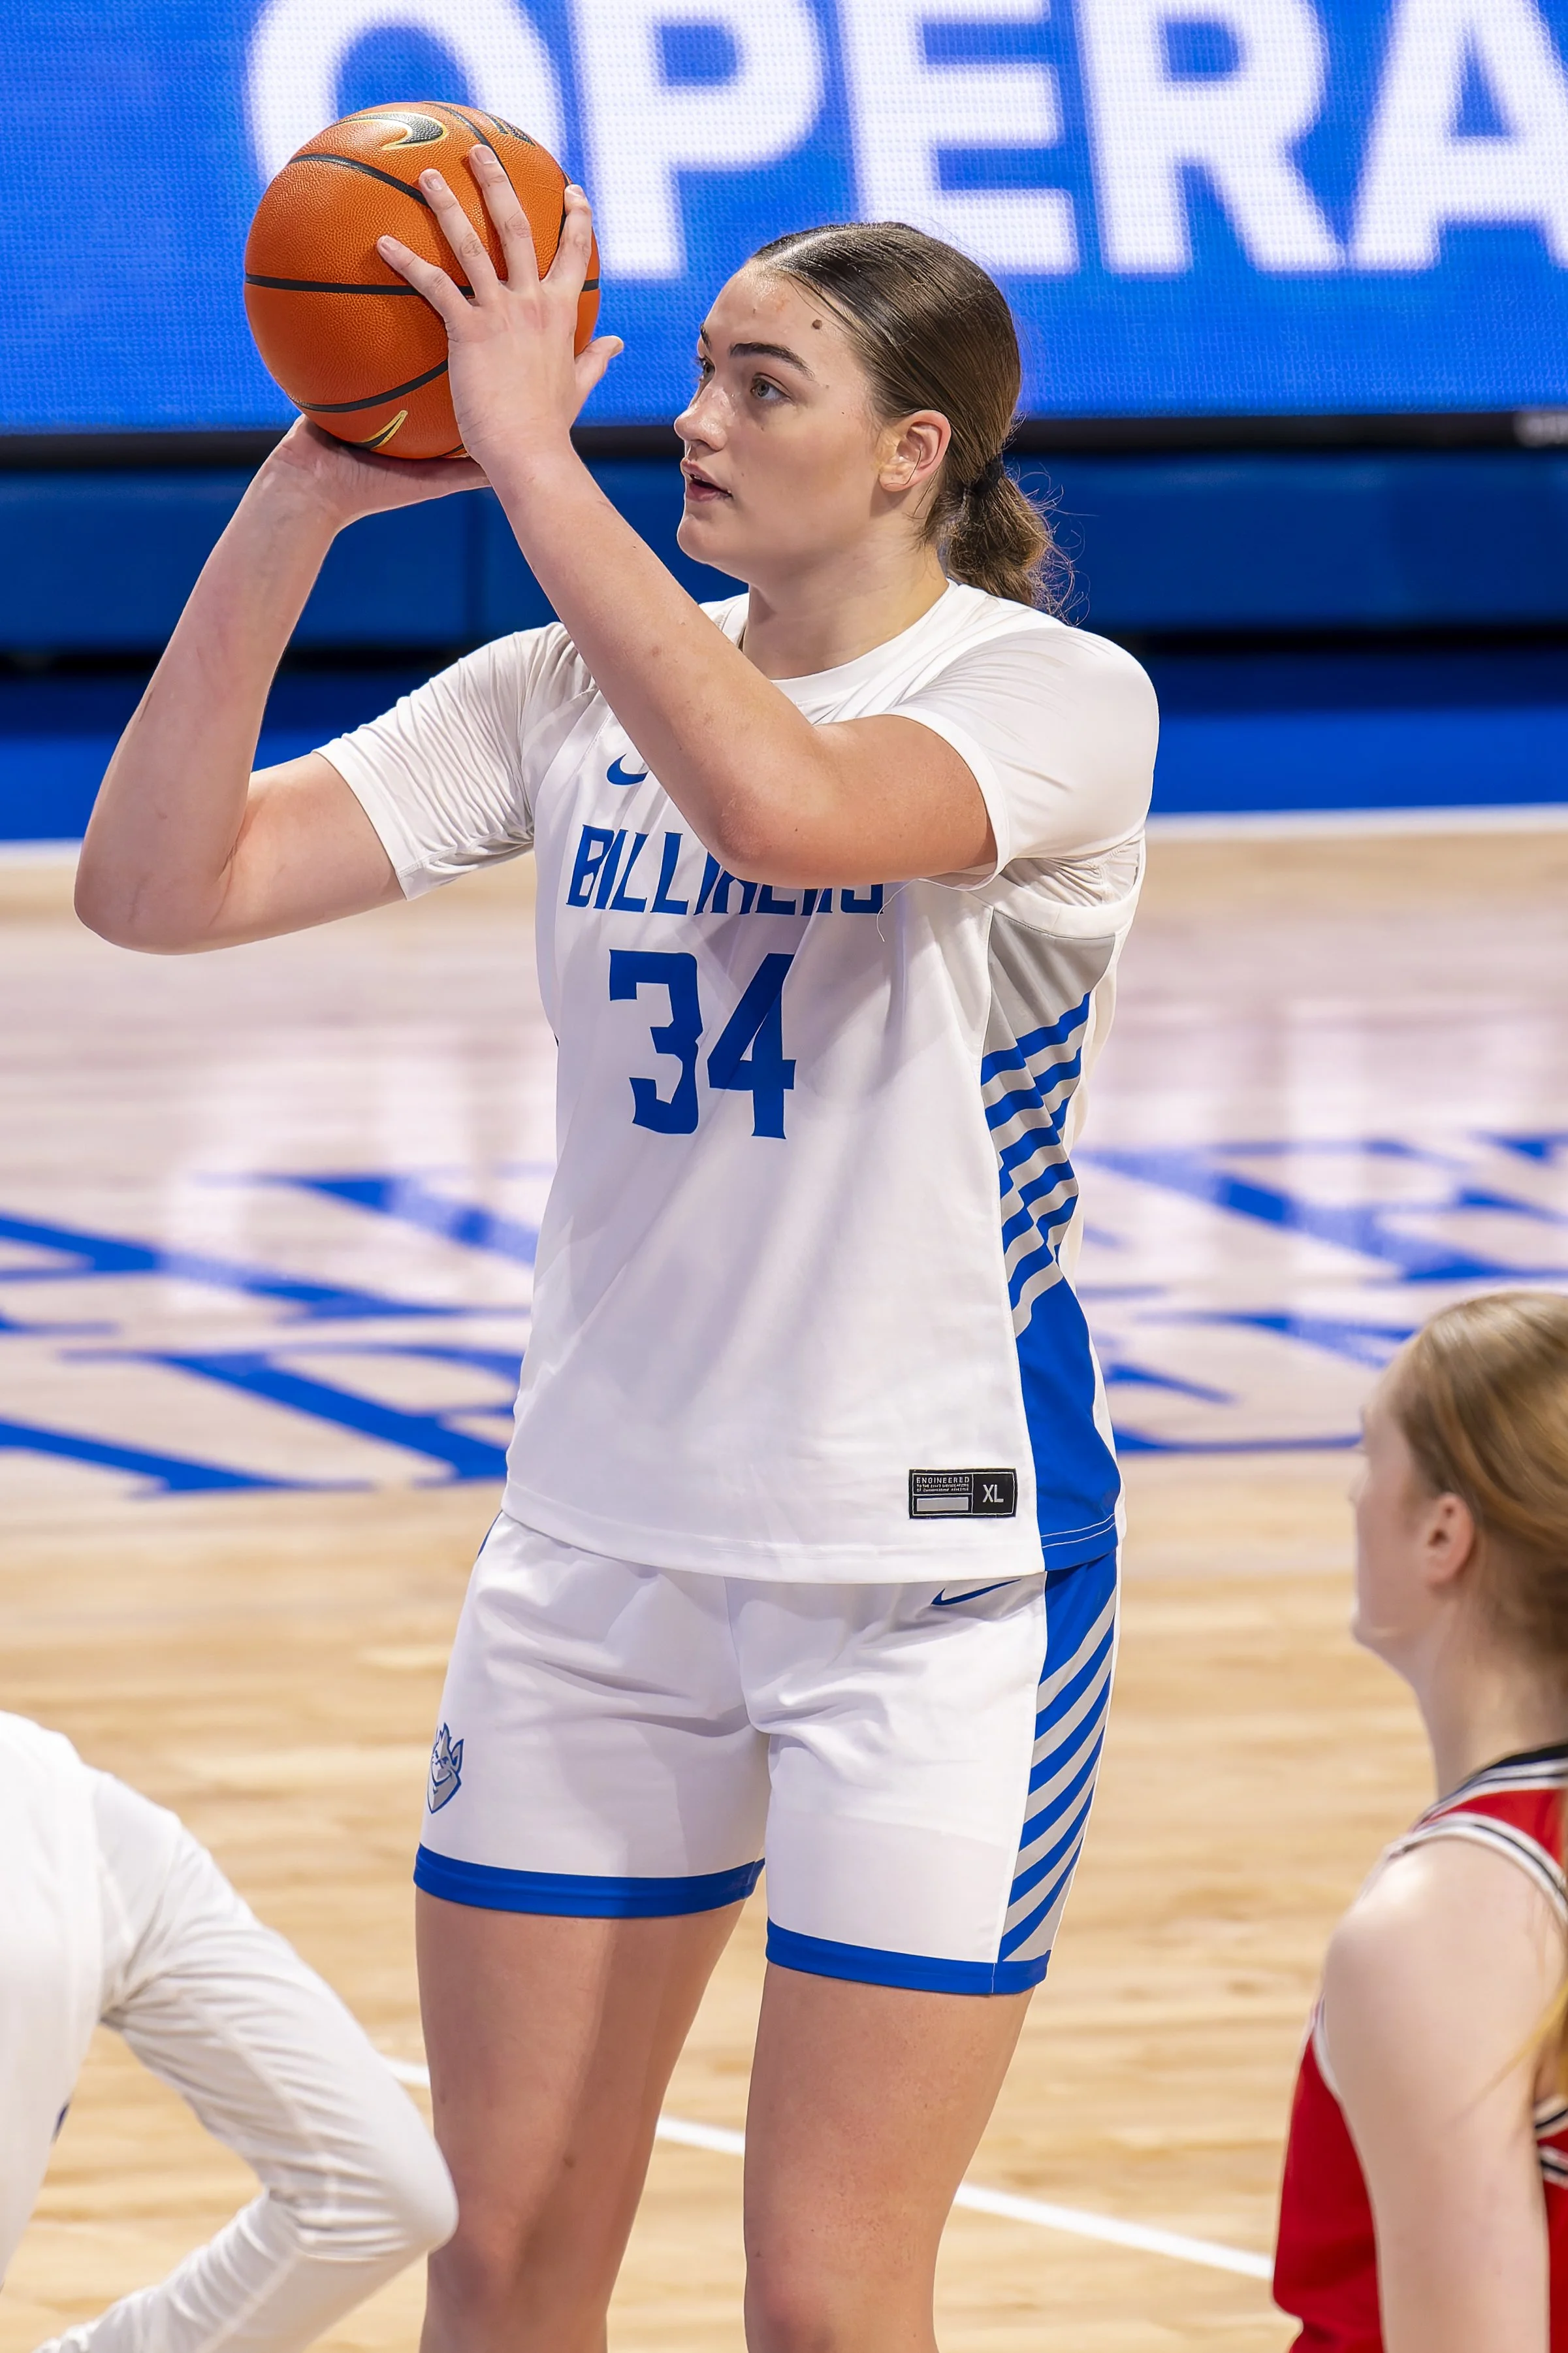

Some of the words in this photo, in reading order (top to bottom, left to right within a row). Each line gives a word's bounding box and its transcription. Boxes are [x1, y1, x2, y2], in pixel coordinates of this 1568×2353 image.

[566, 824, 884, 915] BILLIK
[609, 949, 797, 1139] 34
[982, 1484, 1004, 1502] XL
